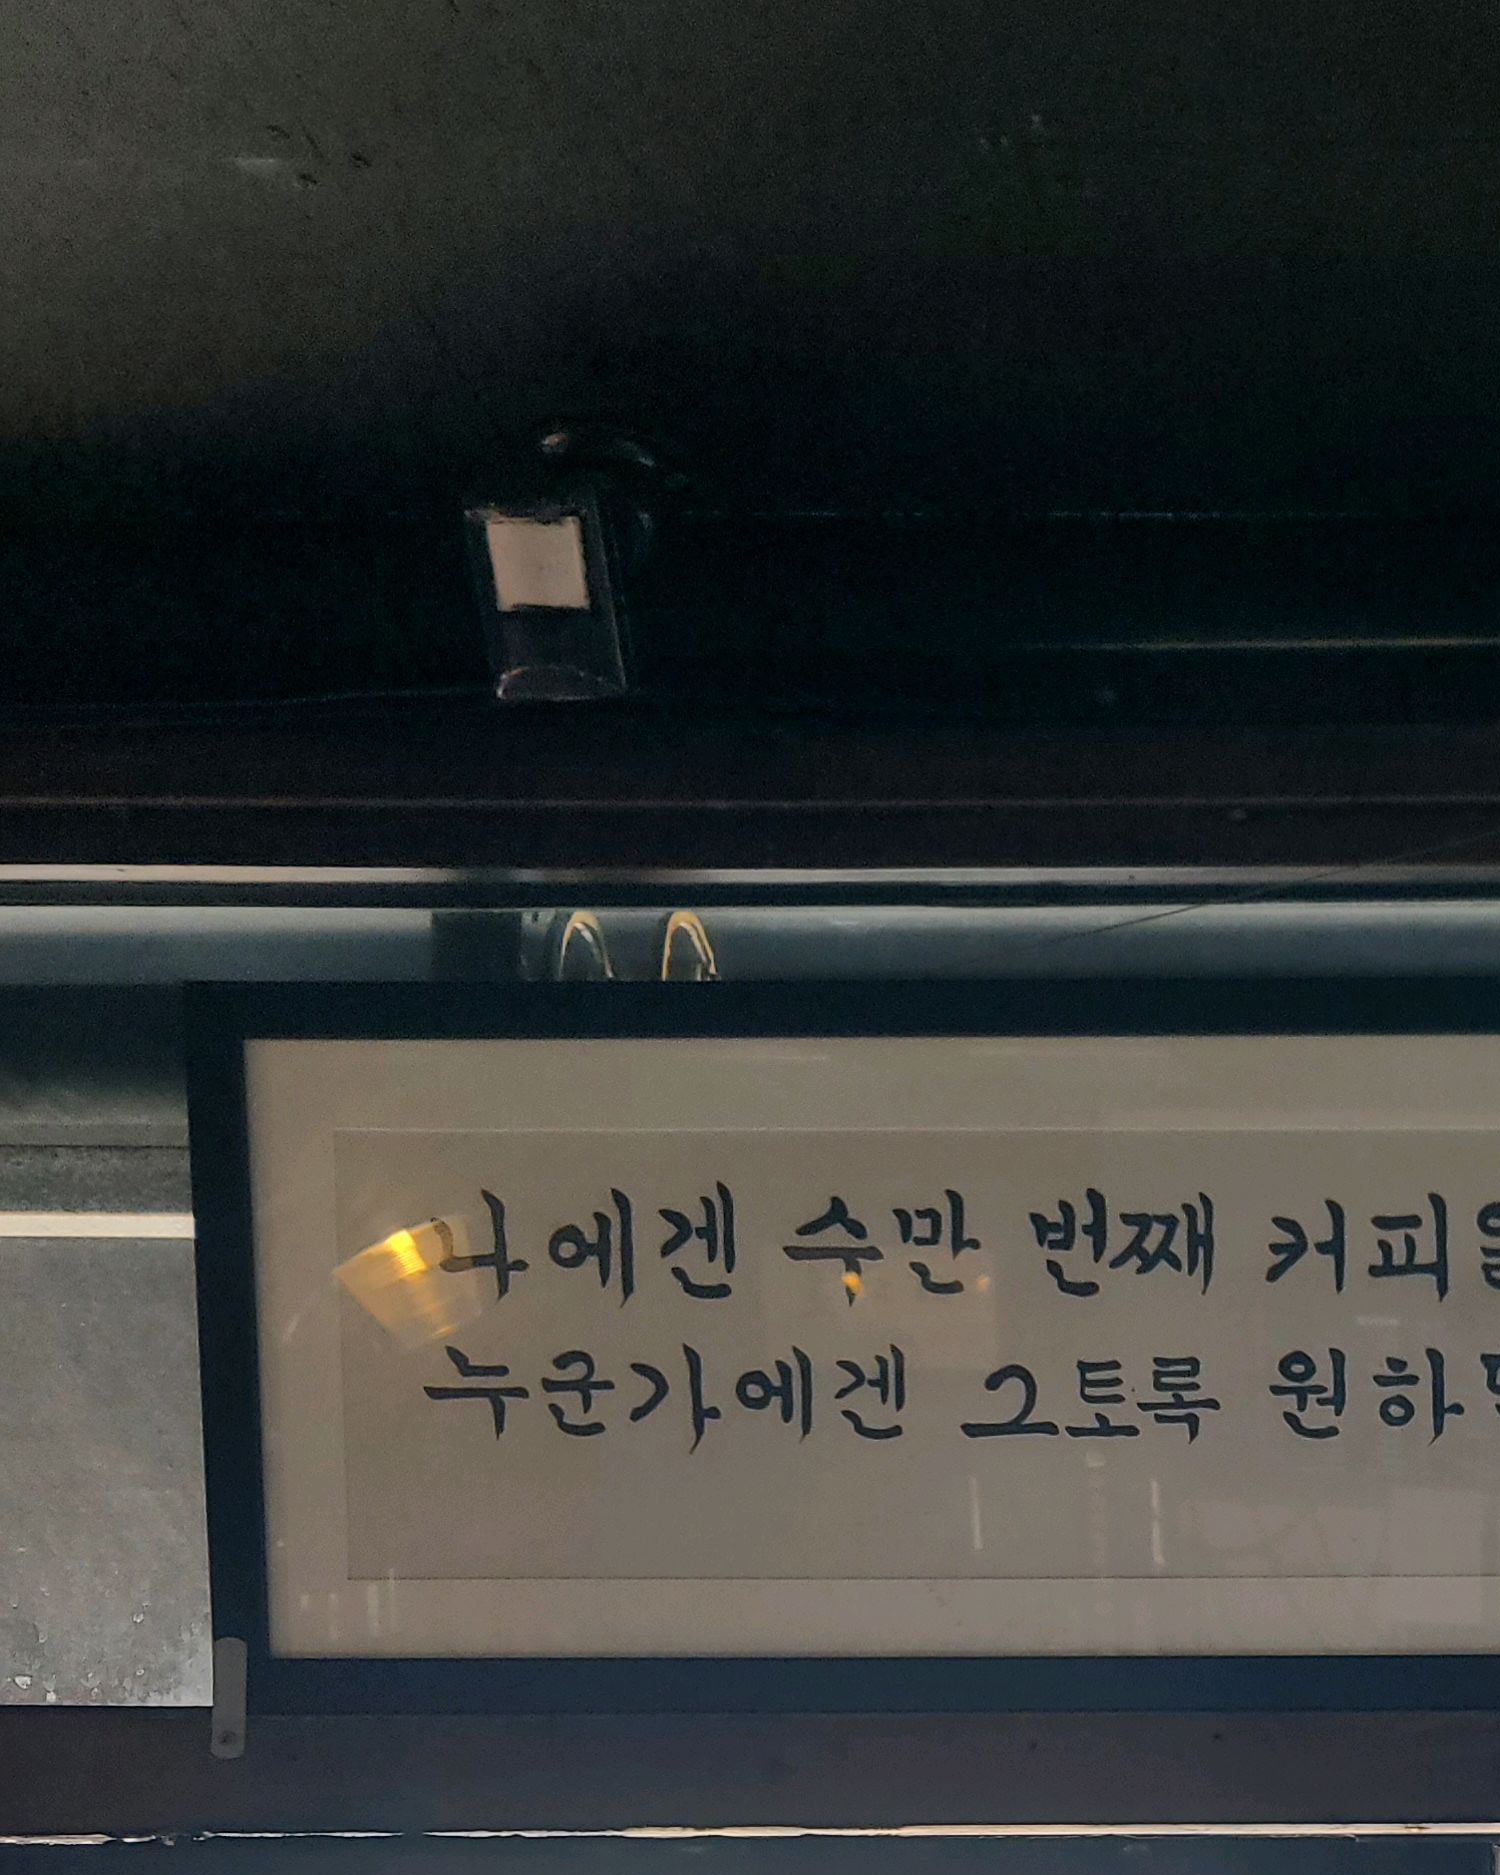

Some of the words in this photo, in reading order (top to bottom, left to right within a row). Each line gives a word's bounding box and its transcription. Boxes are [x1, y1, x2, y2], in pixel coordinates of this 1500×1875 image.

[431, 1181, 737, 1306] 나에겐
[783, 1190, 980, 1305] 수만
[1029, 1188, 1214, 1296] 번째
[424, 1343, 906, 1454] 누군가에겐
[960, 1355, 1221, 1443] 그토록
